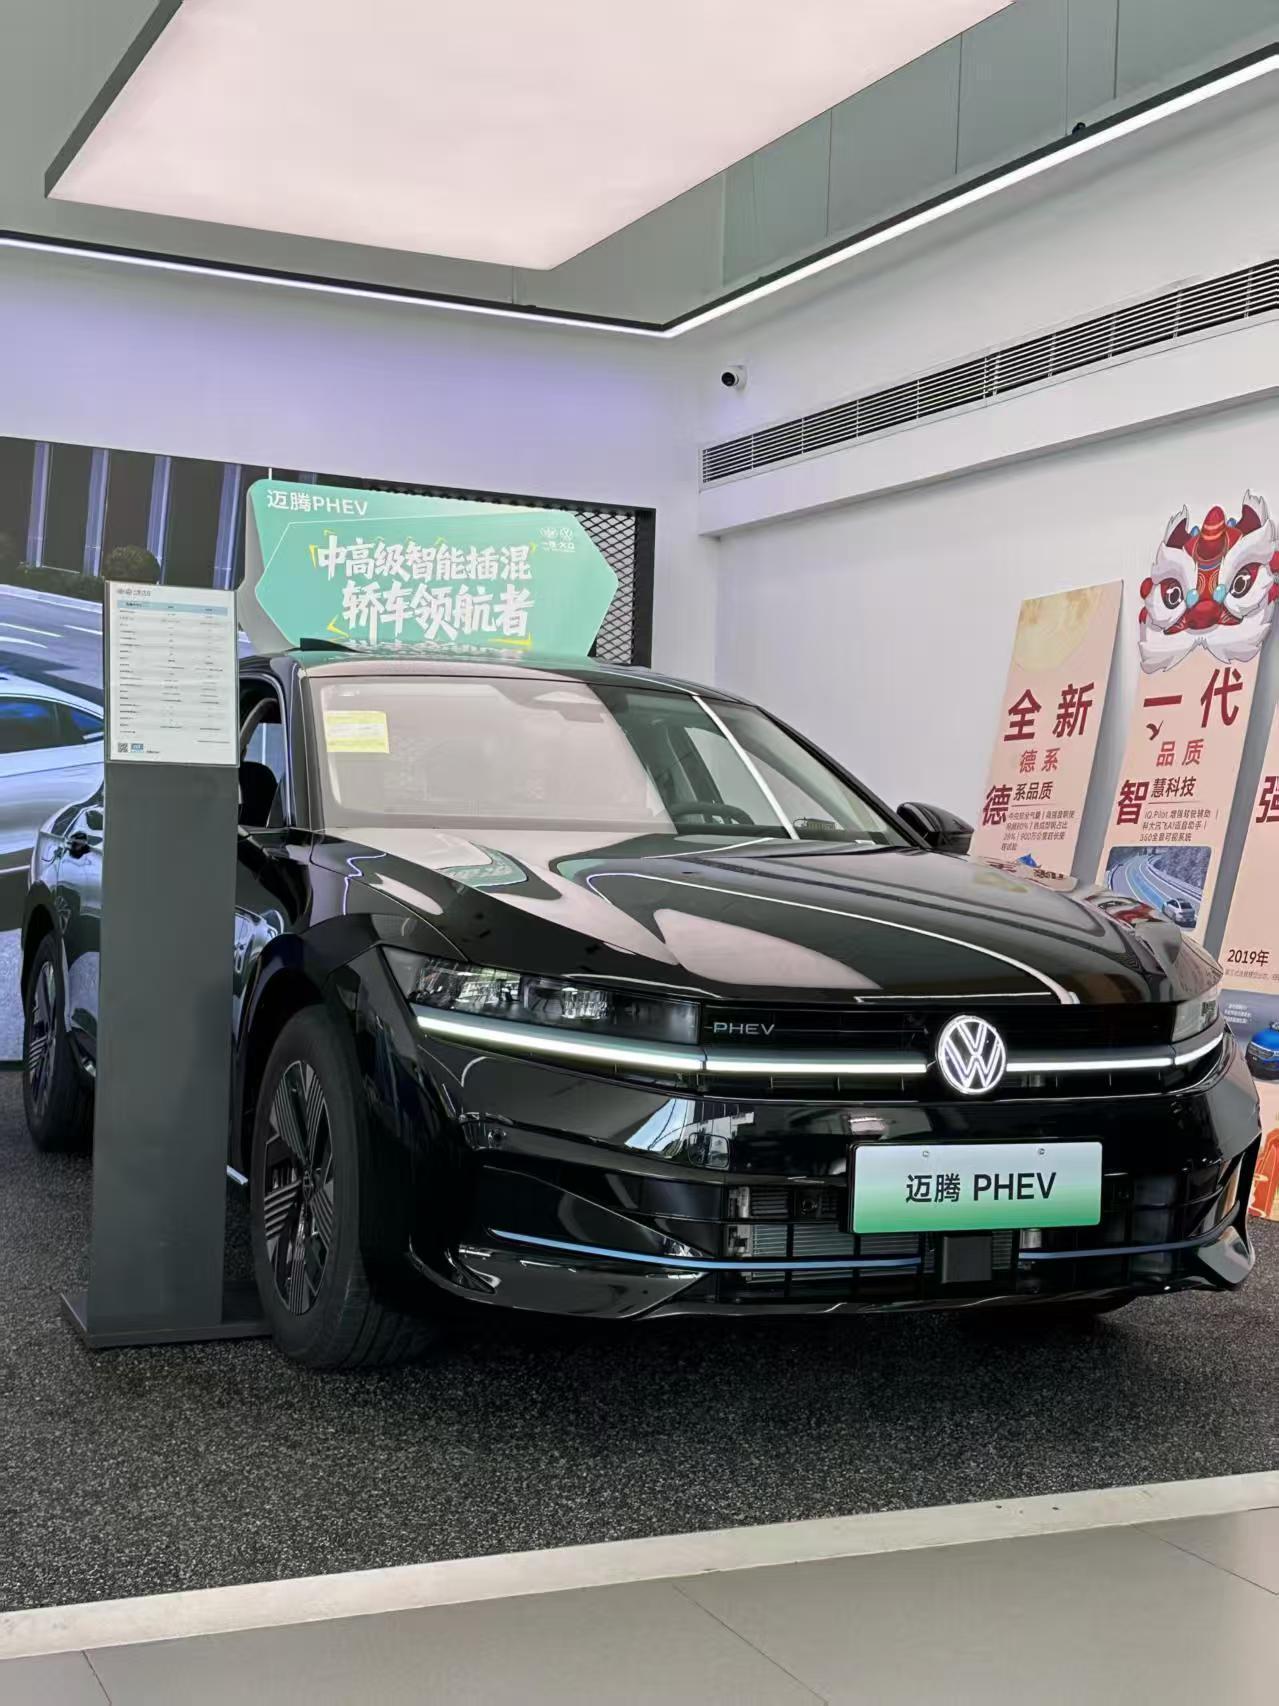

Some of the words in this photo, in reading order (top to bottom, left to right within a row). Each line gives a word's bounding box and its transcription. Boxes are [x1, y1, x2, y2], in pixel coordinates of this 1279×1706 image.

[267, 489, 369, 516] 迈腾PHEV
[317, 533, 534, 581] 中高级智能插混
[341, 580, 536, 644] 轿车领航者
[1003, 682, 1095, 742] 全新
[1143, 667, 1244, 729] 一代
[1018, 747, 1061, 775] 德系
[1155, 738, 1205, 768] 品质
[1013, 781, 1054, 801] 系品质
[1151, 776, 1197, 798] 慧科技
[1227, 949, 1270, 967] 2019年
[712, 1021, 776, 1036] PHEV
[905, 1173, 961, 1204] 迈腾
[972, 1171, 1058, 1202] PHEV
